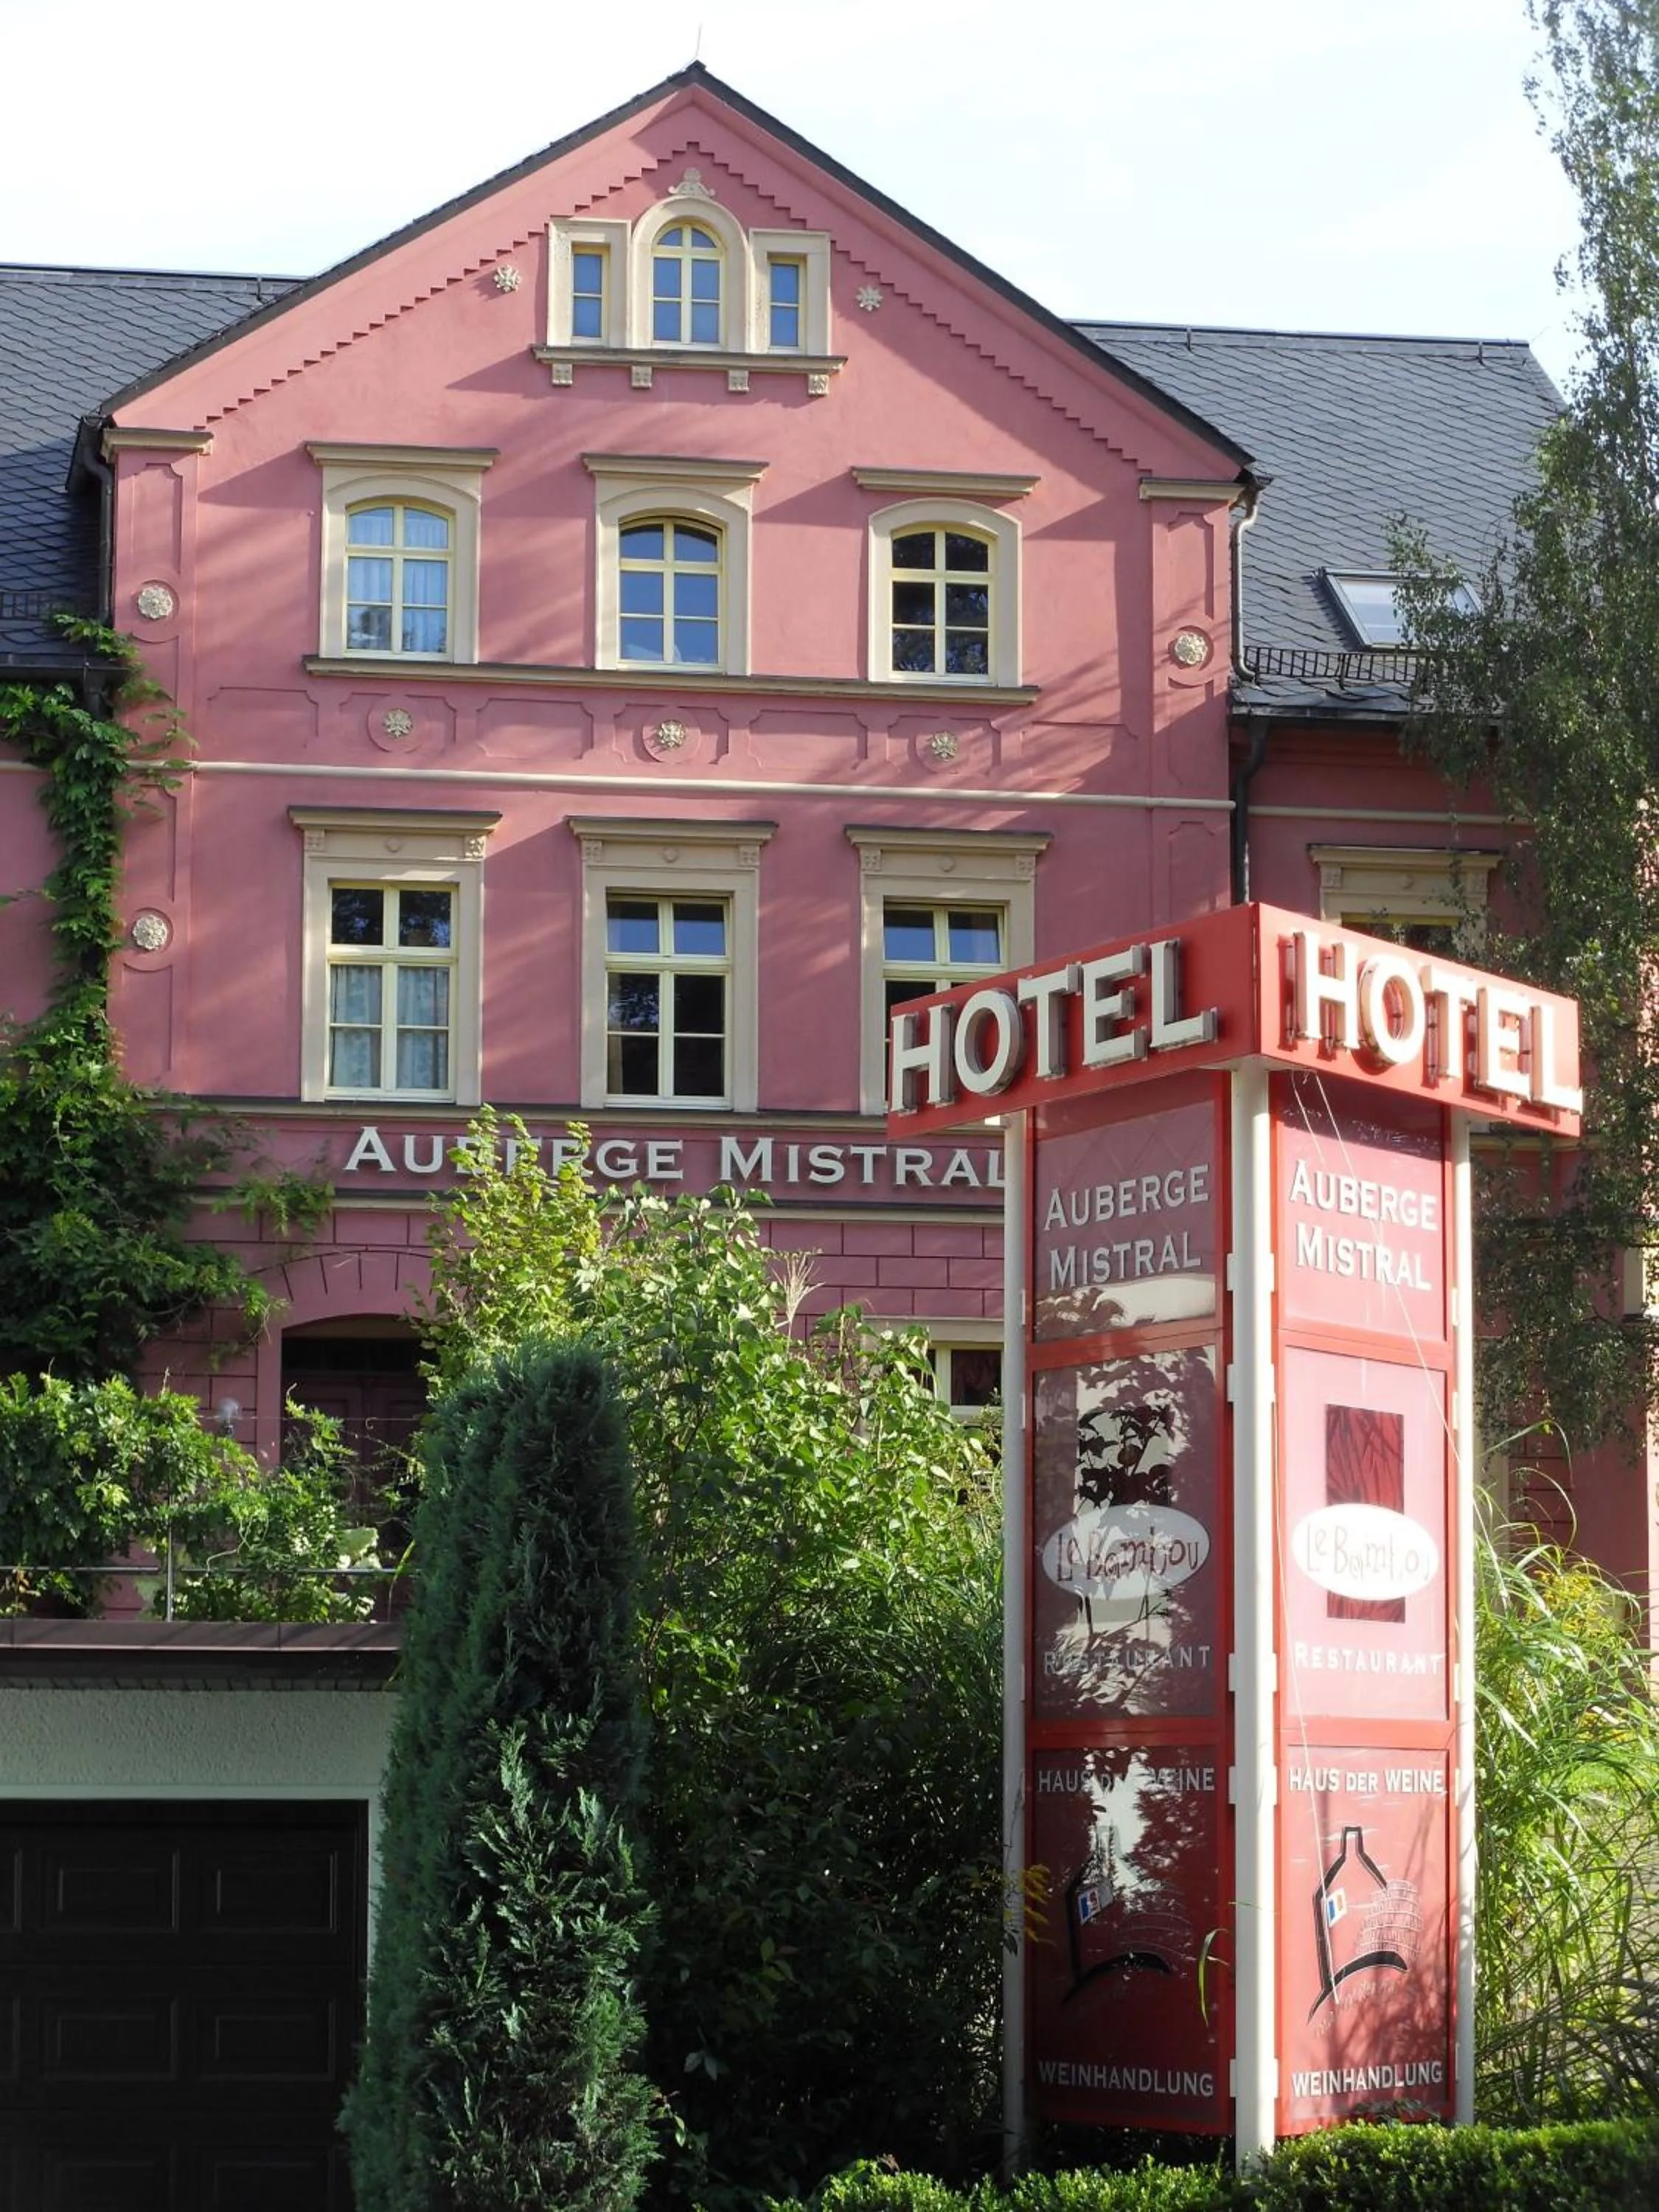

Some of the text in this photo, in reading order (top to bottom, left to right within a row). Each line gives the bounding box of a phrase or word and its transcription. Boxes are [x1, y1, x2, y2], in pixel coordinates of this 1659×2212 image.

[891, 939, 1218, 1116] HOTEL
[1288, 931, 1583, 1115] HOTEL
[720, 1135, 1006, 1189] MISTRAL
[1043, 1163, 1210, 1231] AUBERGE
[1289, 1158, 1439, 1232] AUBERGE
[1050, 1231, 1202, 1290] MISTRAL
[1295, 1221, 1433, 1291] MISTRAL
[1294, 1640, 1447, 1677] RESTAURANT
[1289, 1767, 1445, 1794] HAUS DER WEINE
[1037, 2061, 1214, 2097] WEINHANDLUNG
[1291, 2061, 1443, 2098] WEINHANDLUNG
